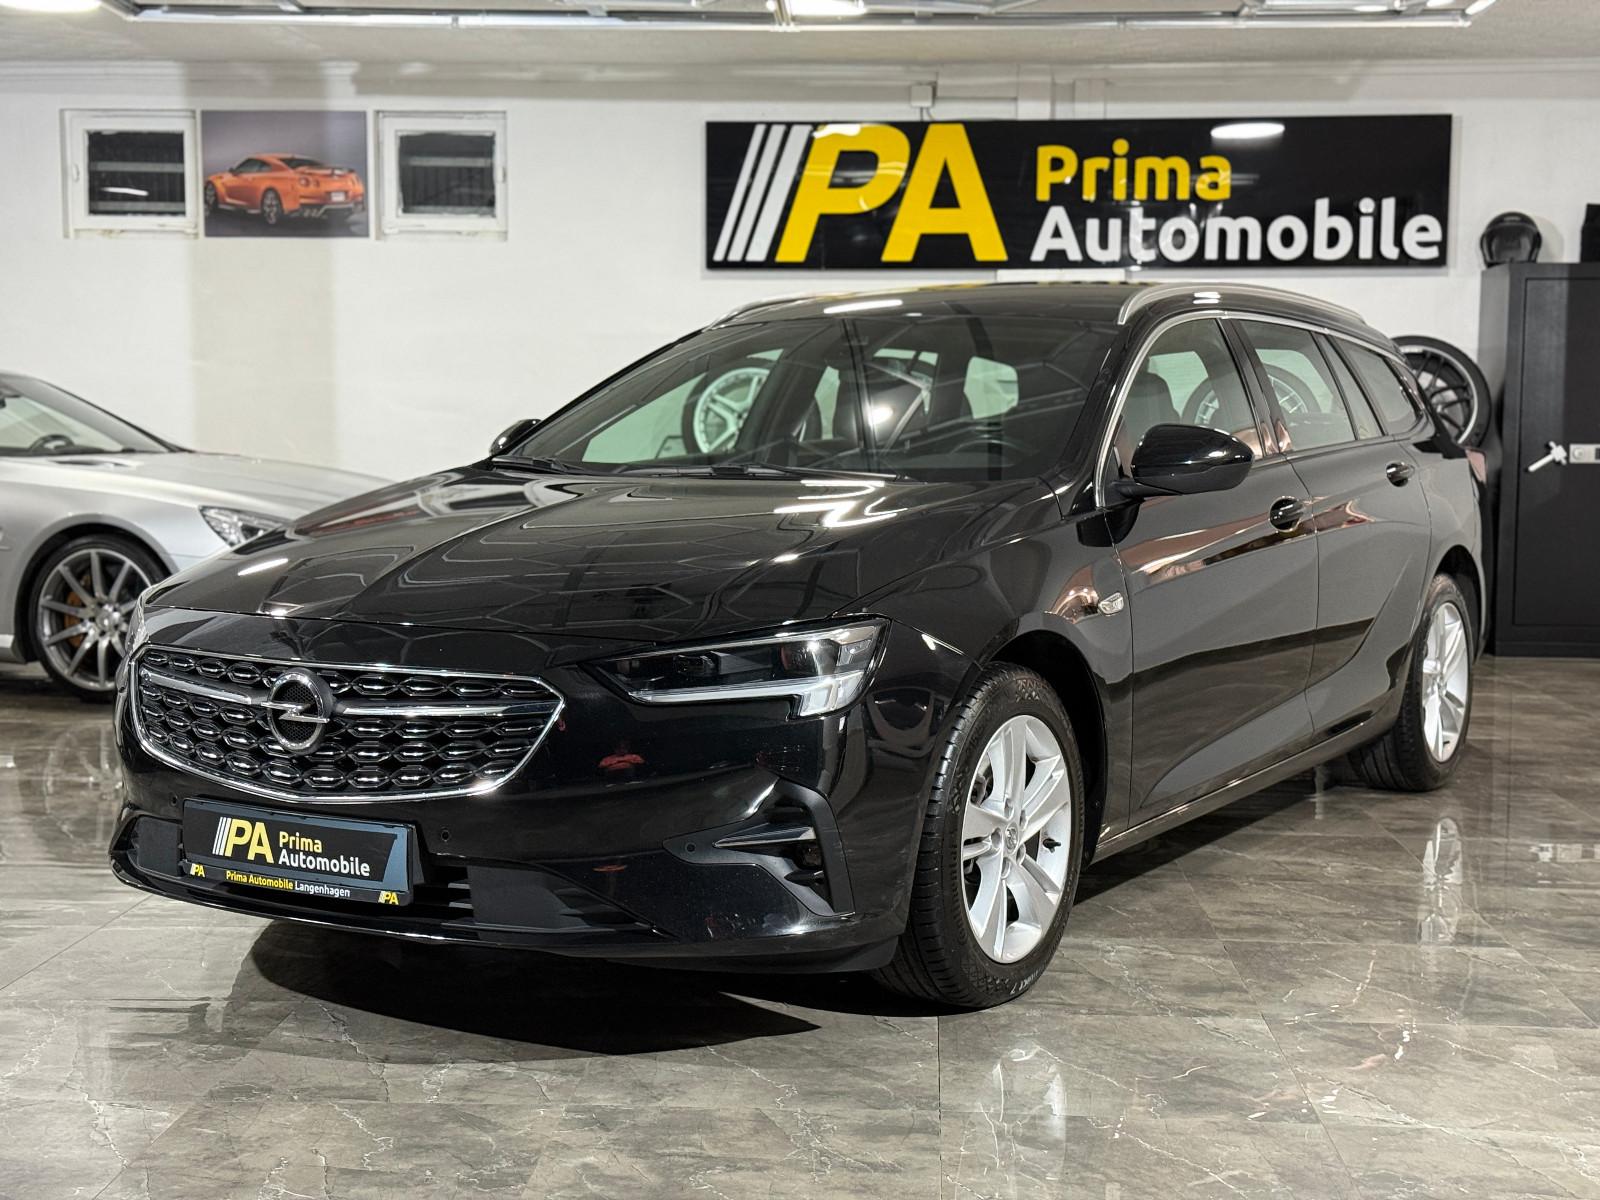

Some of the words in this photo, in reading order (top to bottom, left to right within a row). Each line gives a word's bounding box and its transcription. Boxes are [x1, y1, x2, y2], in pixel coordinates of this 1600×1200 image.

[774, 122, 1009, 263] PA
[1035, 139, 1233, 202] Prima
[1029, 196, 1443, 263] Automobile
[224, 818, 275, 865] PA
[278, 848, 371, 877] Automobile
[279, 830, 323, 854] Prima
[226, 870, 248, 884] Prima
[248, 874, 294, 890] Automobile
[294, 881, 351, 898] Langenhagen
